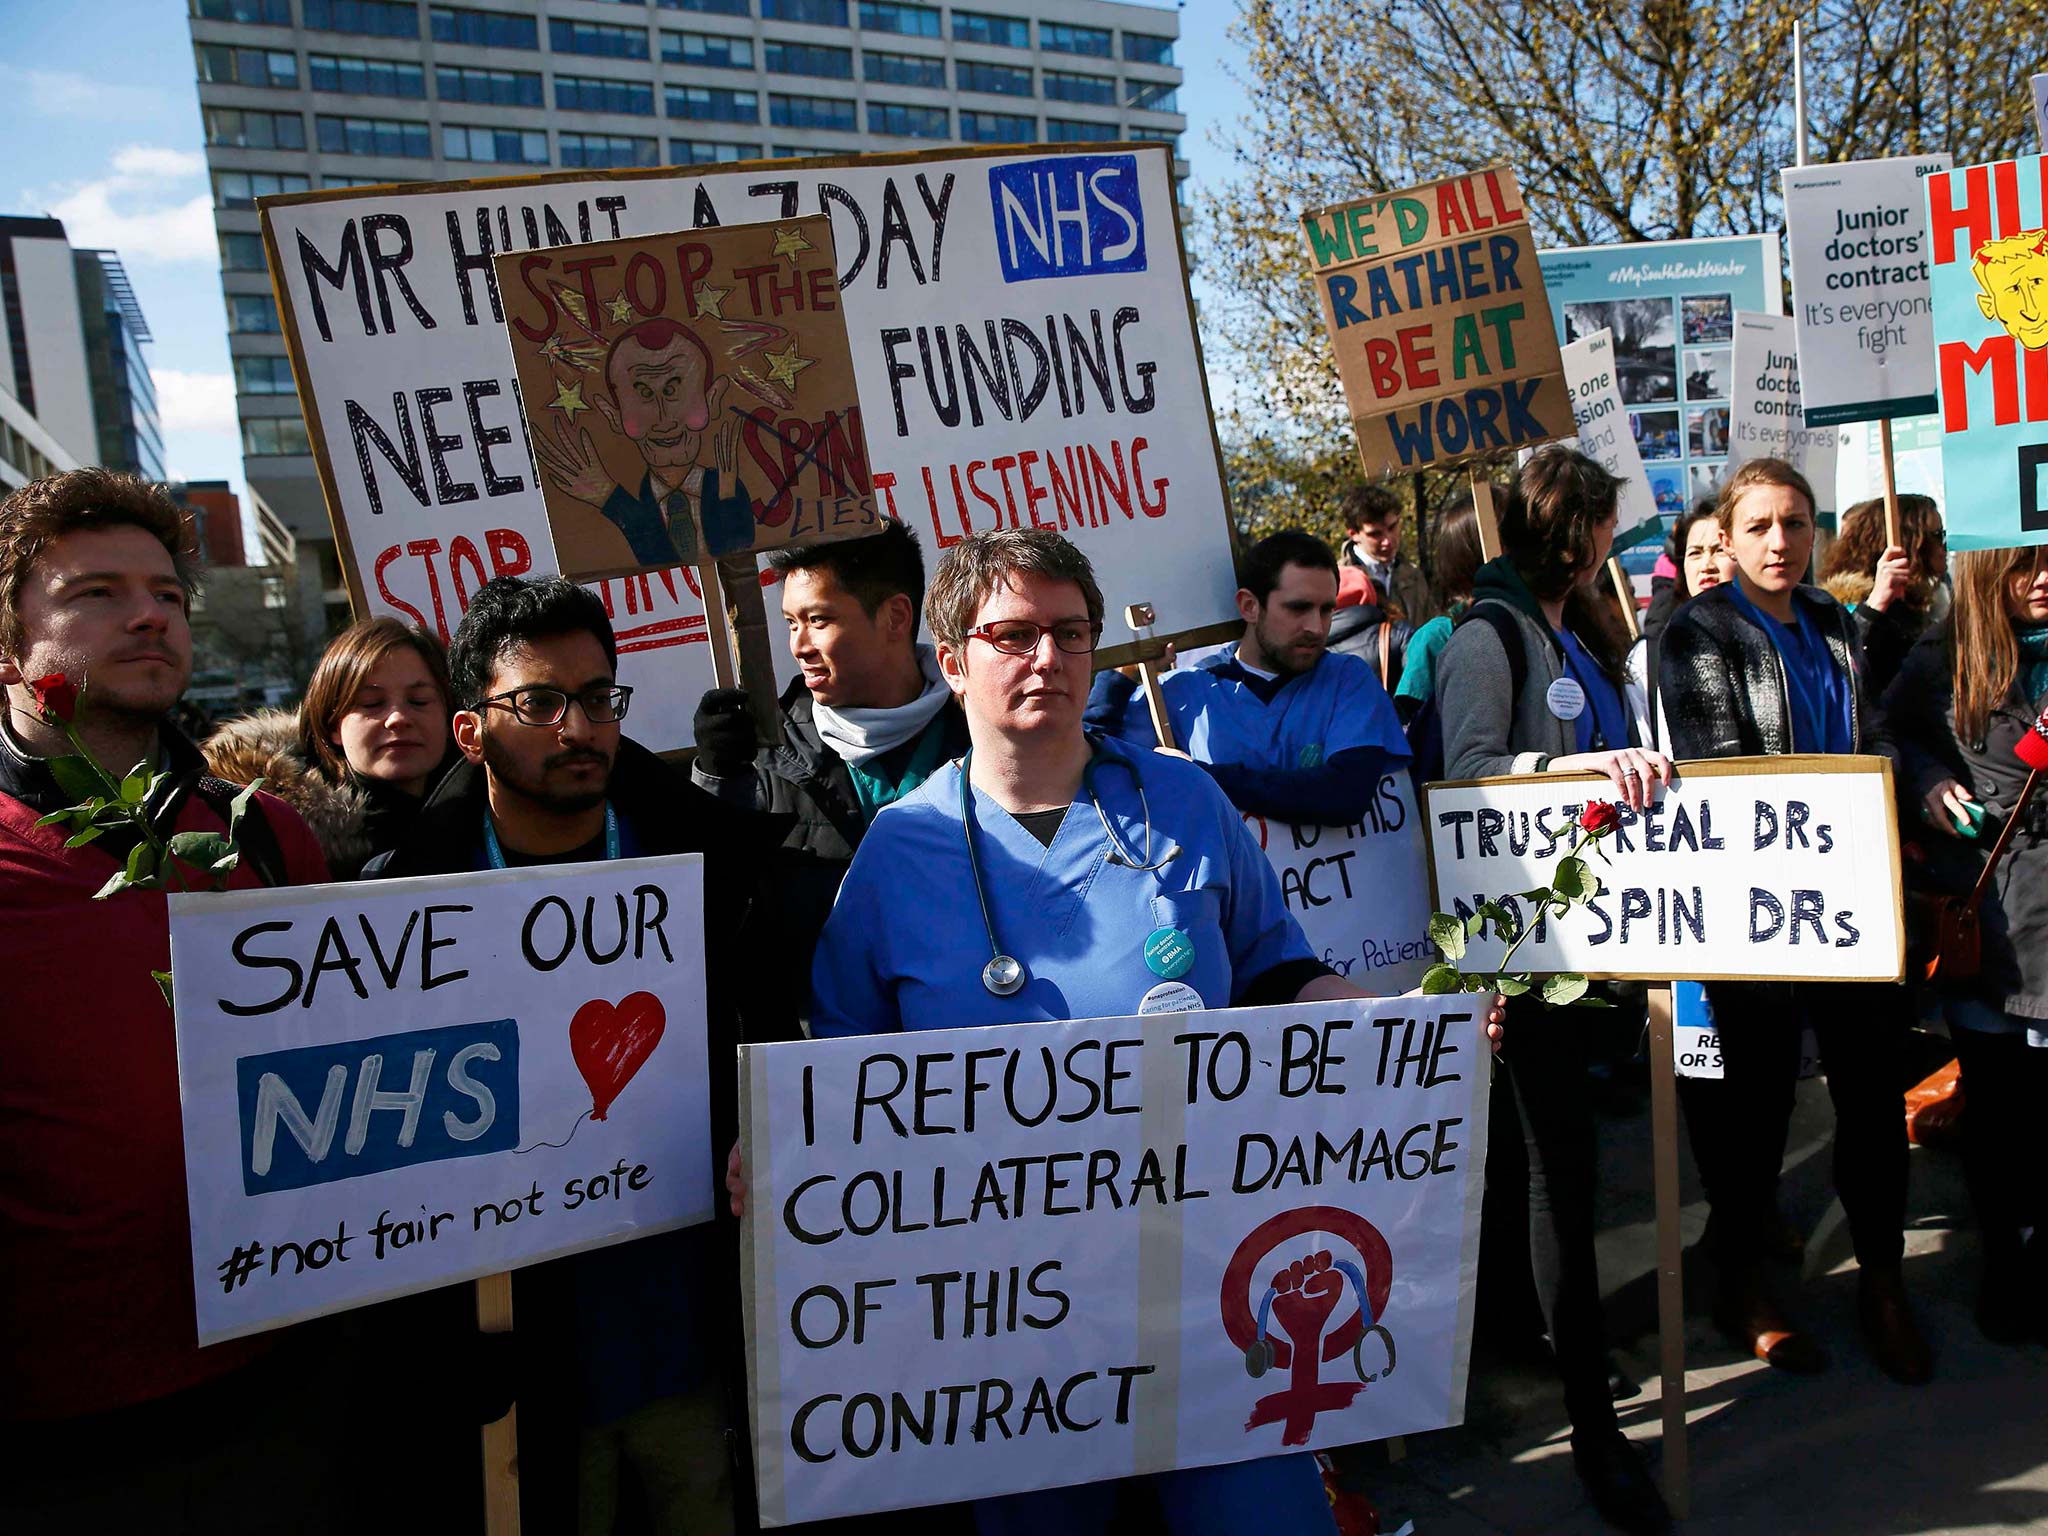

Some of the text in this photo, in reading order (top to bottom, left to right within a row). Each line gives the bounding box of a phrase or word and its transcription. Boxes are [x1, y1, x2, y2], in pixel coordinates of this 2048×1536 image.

[295, 213, 437, 342] MR
[819, 173, 956, 291] DAY
[1002, 167, 1139, 268] NHS
[1302, 172, 1523, 268] WE'D ALL
[1825, 230, 1924, 261] doctors'
[1835, 205, 1910, 236] Junior
[513, 242, 837, 343] STOP THE
[1326, 235, 1522, 330] RATHER
[1805, 302, 1834, 326] It's
[1826, 260, 1930, 291] contract
[1364, 302, 1526, 399] BE AT
[1858, 324, 1907, 354] fight
[344, 307, 1157, 514] NEE FUNDING
[1385, 378, 1549, 466] WORK
[1580, 373, 1610, 398] one
[742, 405, 871, 528] SPIN
[1737, 421, 1834, 449] It's everyone's
[790, 499, 875, 537] LIES
[921, 437, 1170, 549] LISTENING
[1346, 776, 1405, 839] HIS
[1439, 800, 1834, 859] TRUST REAL DRs
[218, 884, 674, 1017] SAVE OUR
[1167, 945, 1183, 959] BMA
[1586, 885, 1706, 946] SPIN
[1749, 887, 1860, 948] DRs
[1142, 1004, 1162, 1015] Caring
[1171, 994, 1197, 1007] patients
[1148, 987, 1186, 1001] #oneprofession
[802, 1013, 1473, 1147] I REFUSE TO BE THE
[1680, 1053, 1708, 1068] OR
[251, 1042, 502, 1176] NHS
[783, 1117, 1463, 1245] COLLATERAL DAMAGE
[218, 1158, 654, 1293] #not fair not safe
[791, 1260, 1070, 1349] OF THIS
[790, 1365, 1156, 1463] CONTRACT
